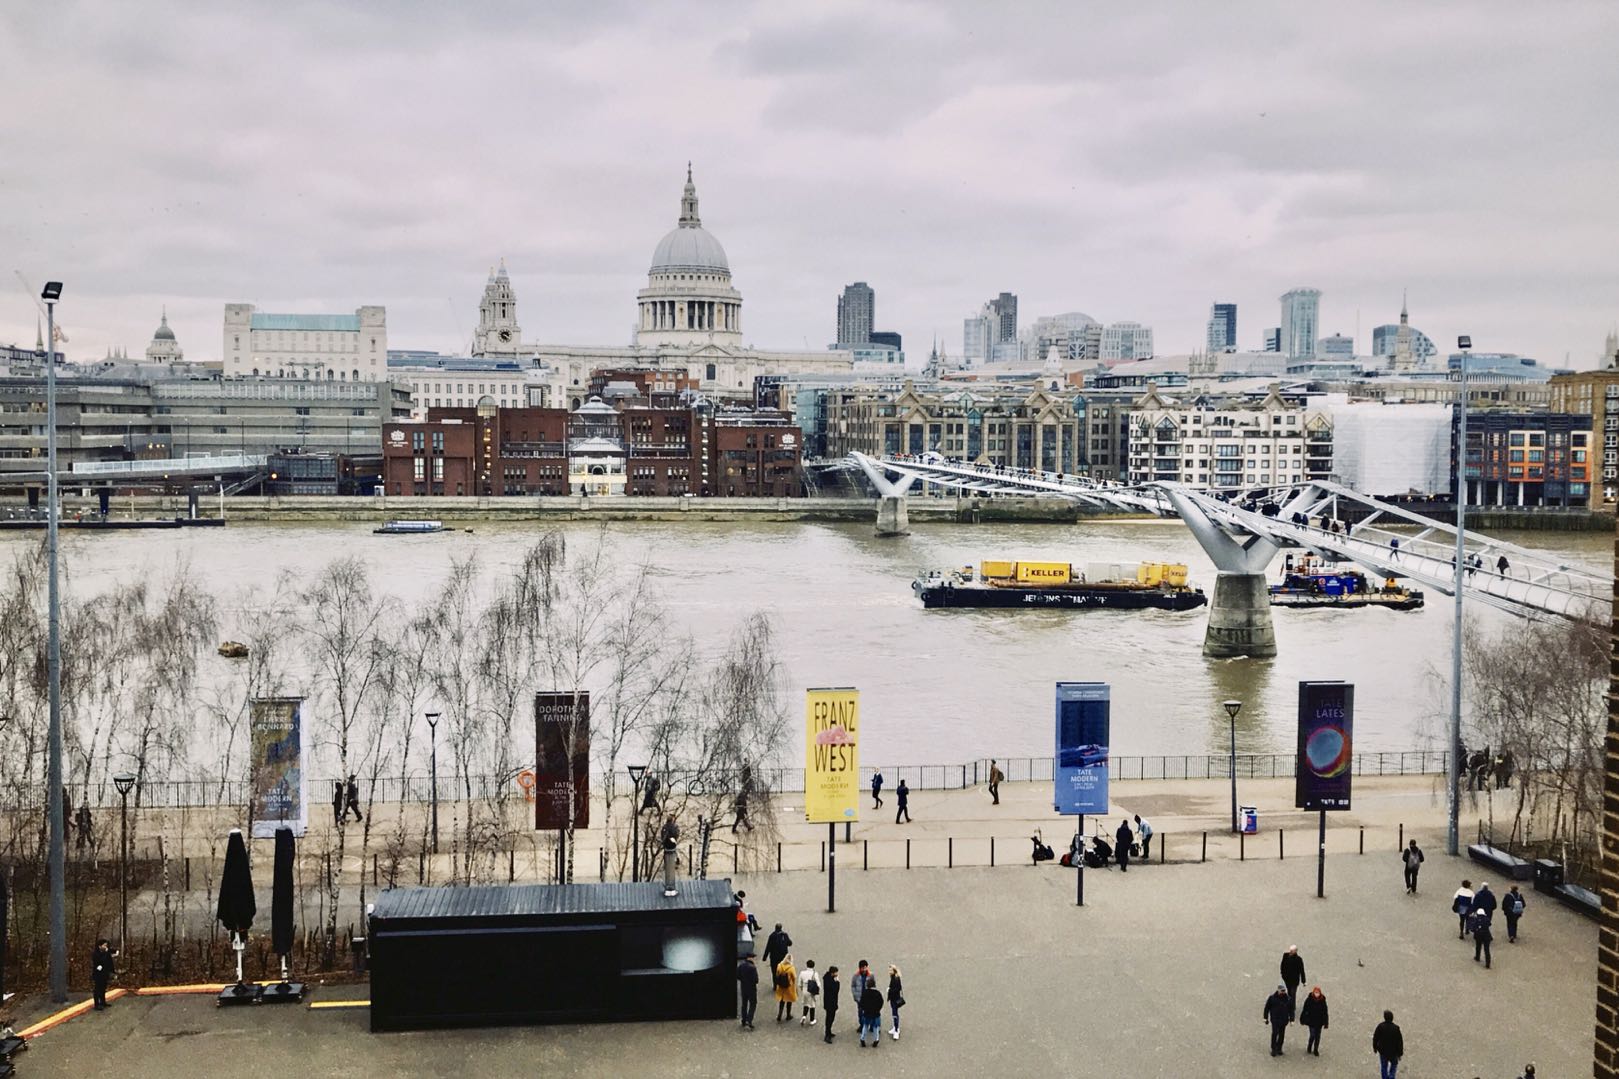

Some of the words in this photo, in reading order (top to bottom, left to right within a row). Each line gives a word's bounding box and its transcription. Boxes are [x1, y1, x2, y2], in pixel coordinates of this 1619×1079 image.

[1031, 569, 1065, 577] KELLER
[814, 700, 856, 732] FRANZ
[1316, 708, 1345, 719] LATES
[814, 744, 856, 773] WEST
[1070, 775, 1099, 783] MODERN
